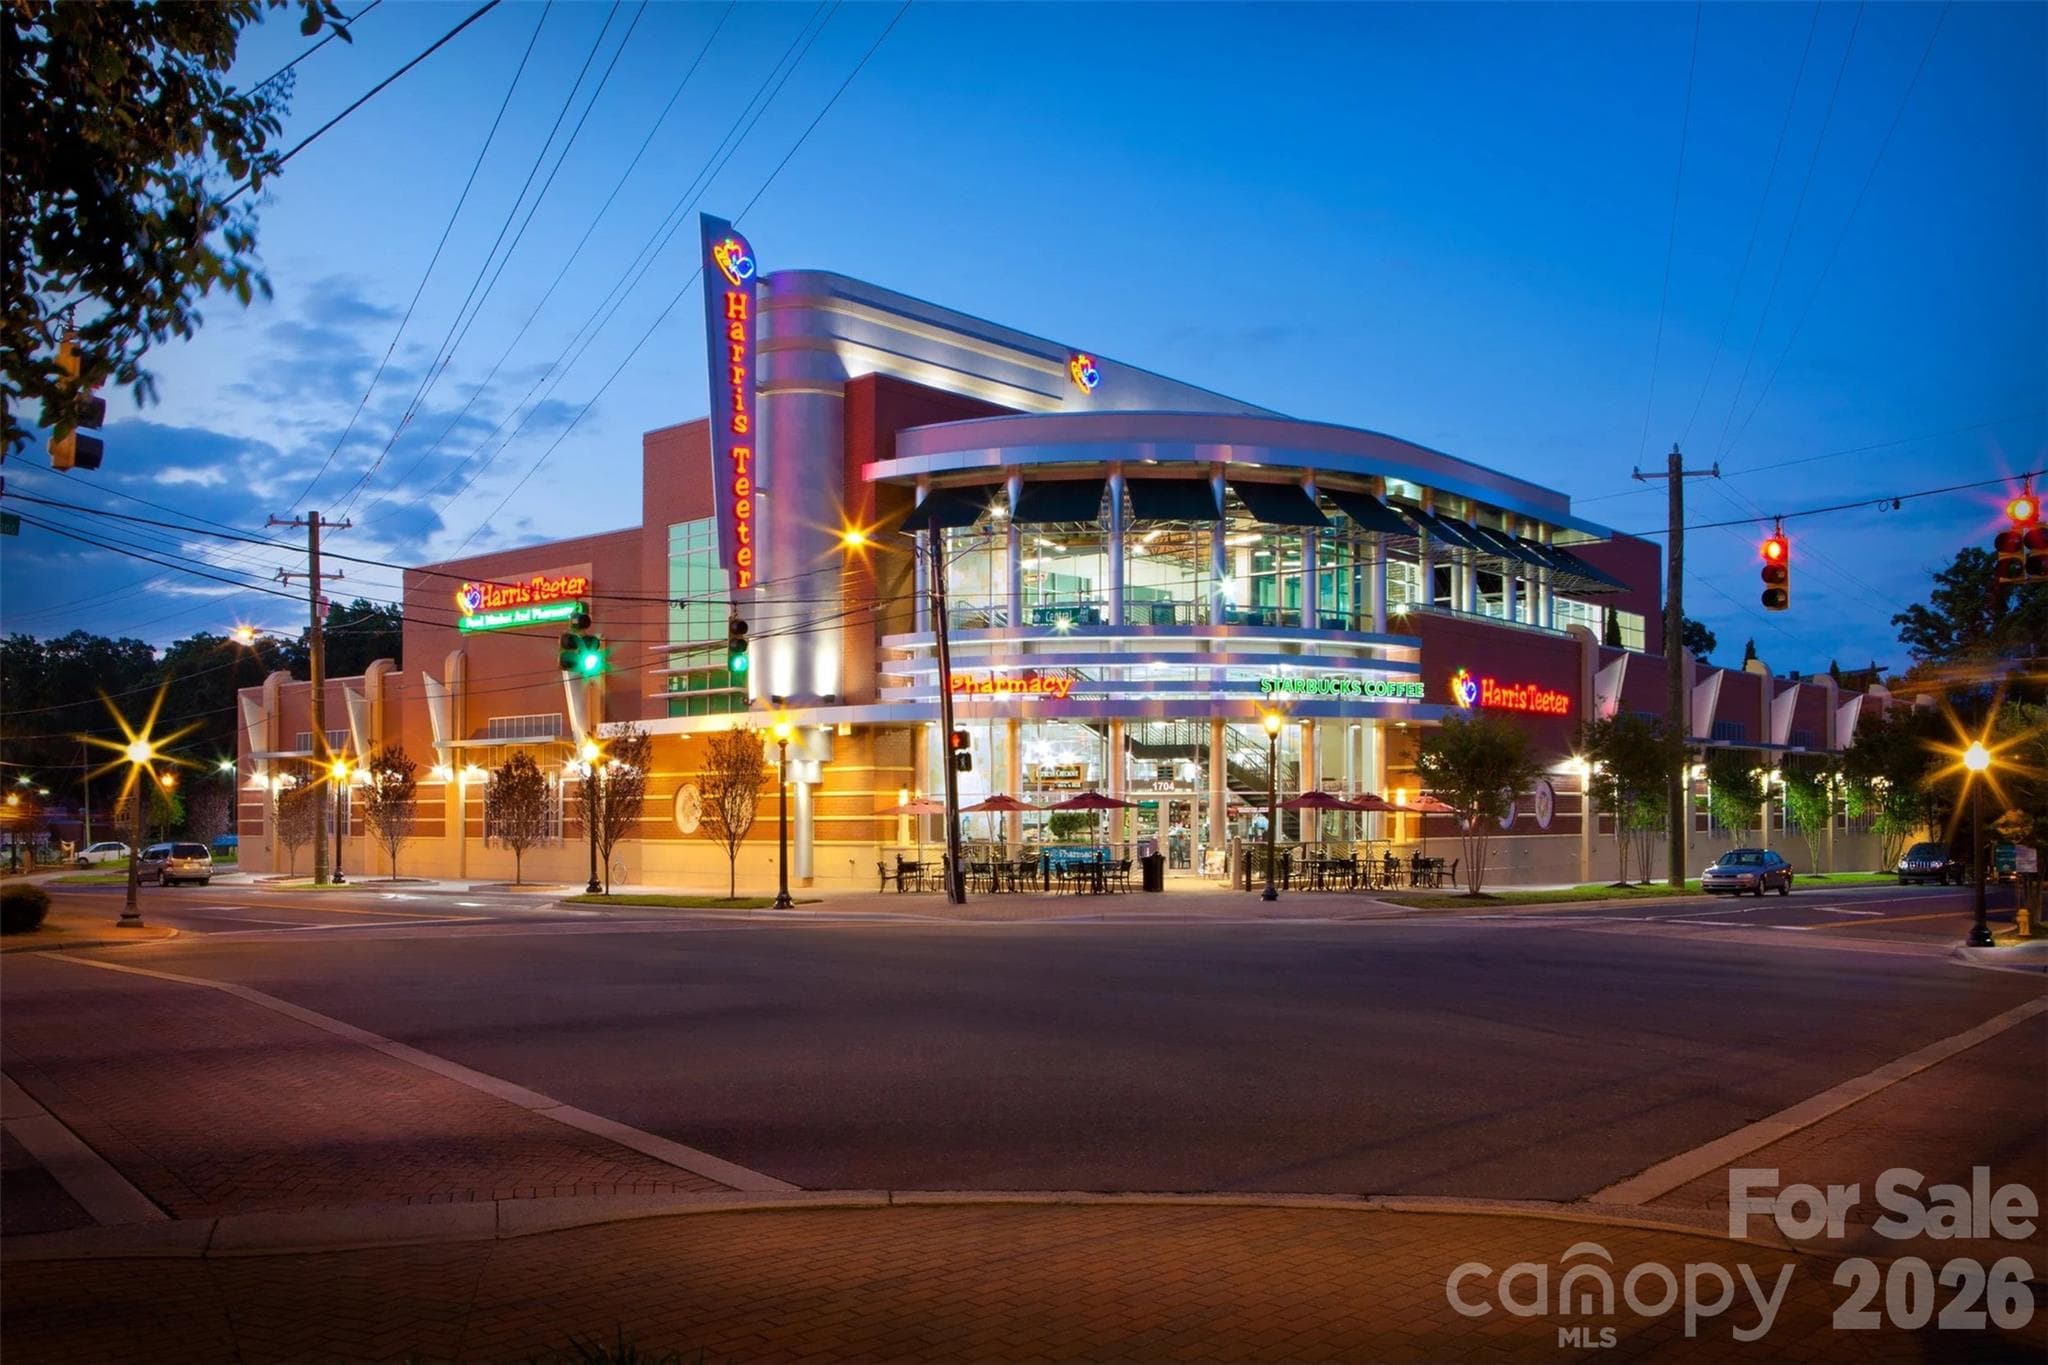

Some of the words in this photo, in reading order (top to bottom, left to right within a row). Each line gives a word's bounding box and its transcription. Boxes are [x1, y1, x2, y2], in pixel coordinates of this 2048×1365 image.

[726, 291, 749, 434] Harris
[732, 447, 752, 588] Teeter
[479, 581, 530, 609] Harris
[531, 576, 587, 599] Teeter
[949, 673, 1072, 698] Pharmacy
[1261, 677, 1361, 695] STARBUCKS
[1364, 680, 1424, 698] COFFEE
[1480, 678, 1527, 709] Harris
[1528, 684, 1569, 714] Teeter
[1152, 781, 1175, 791] 1704
